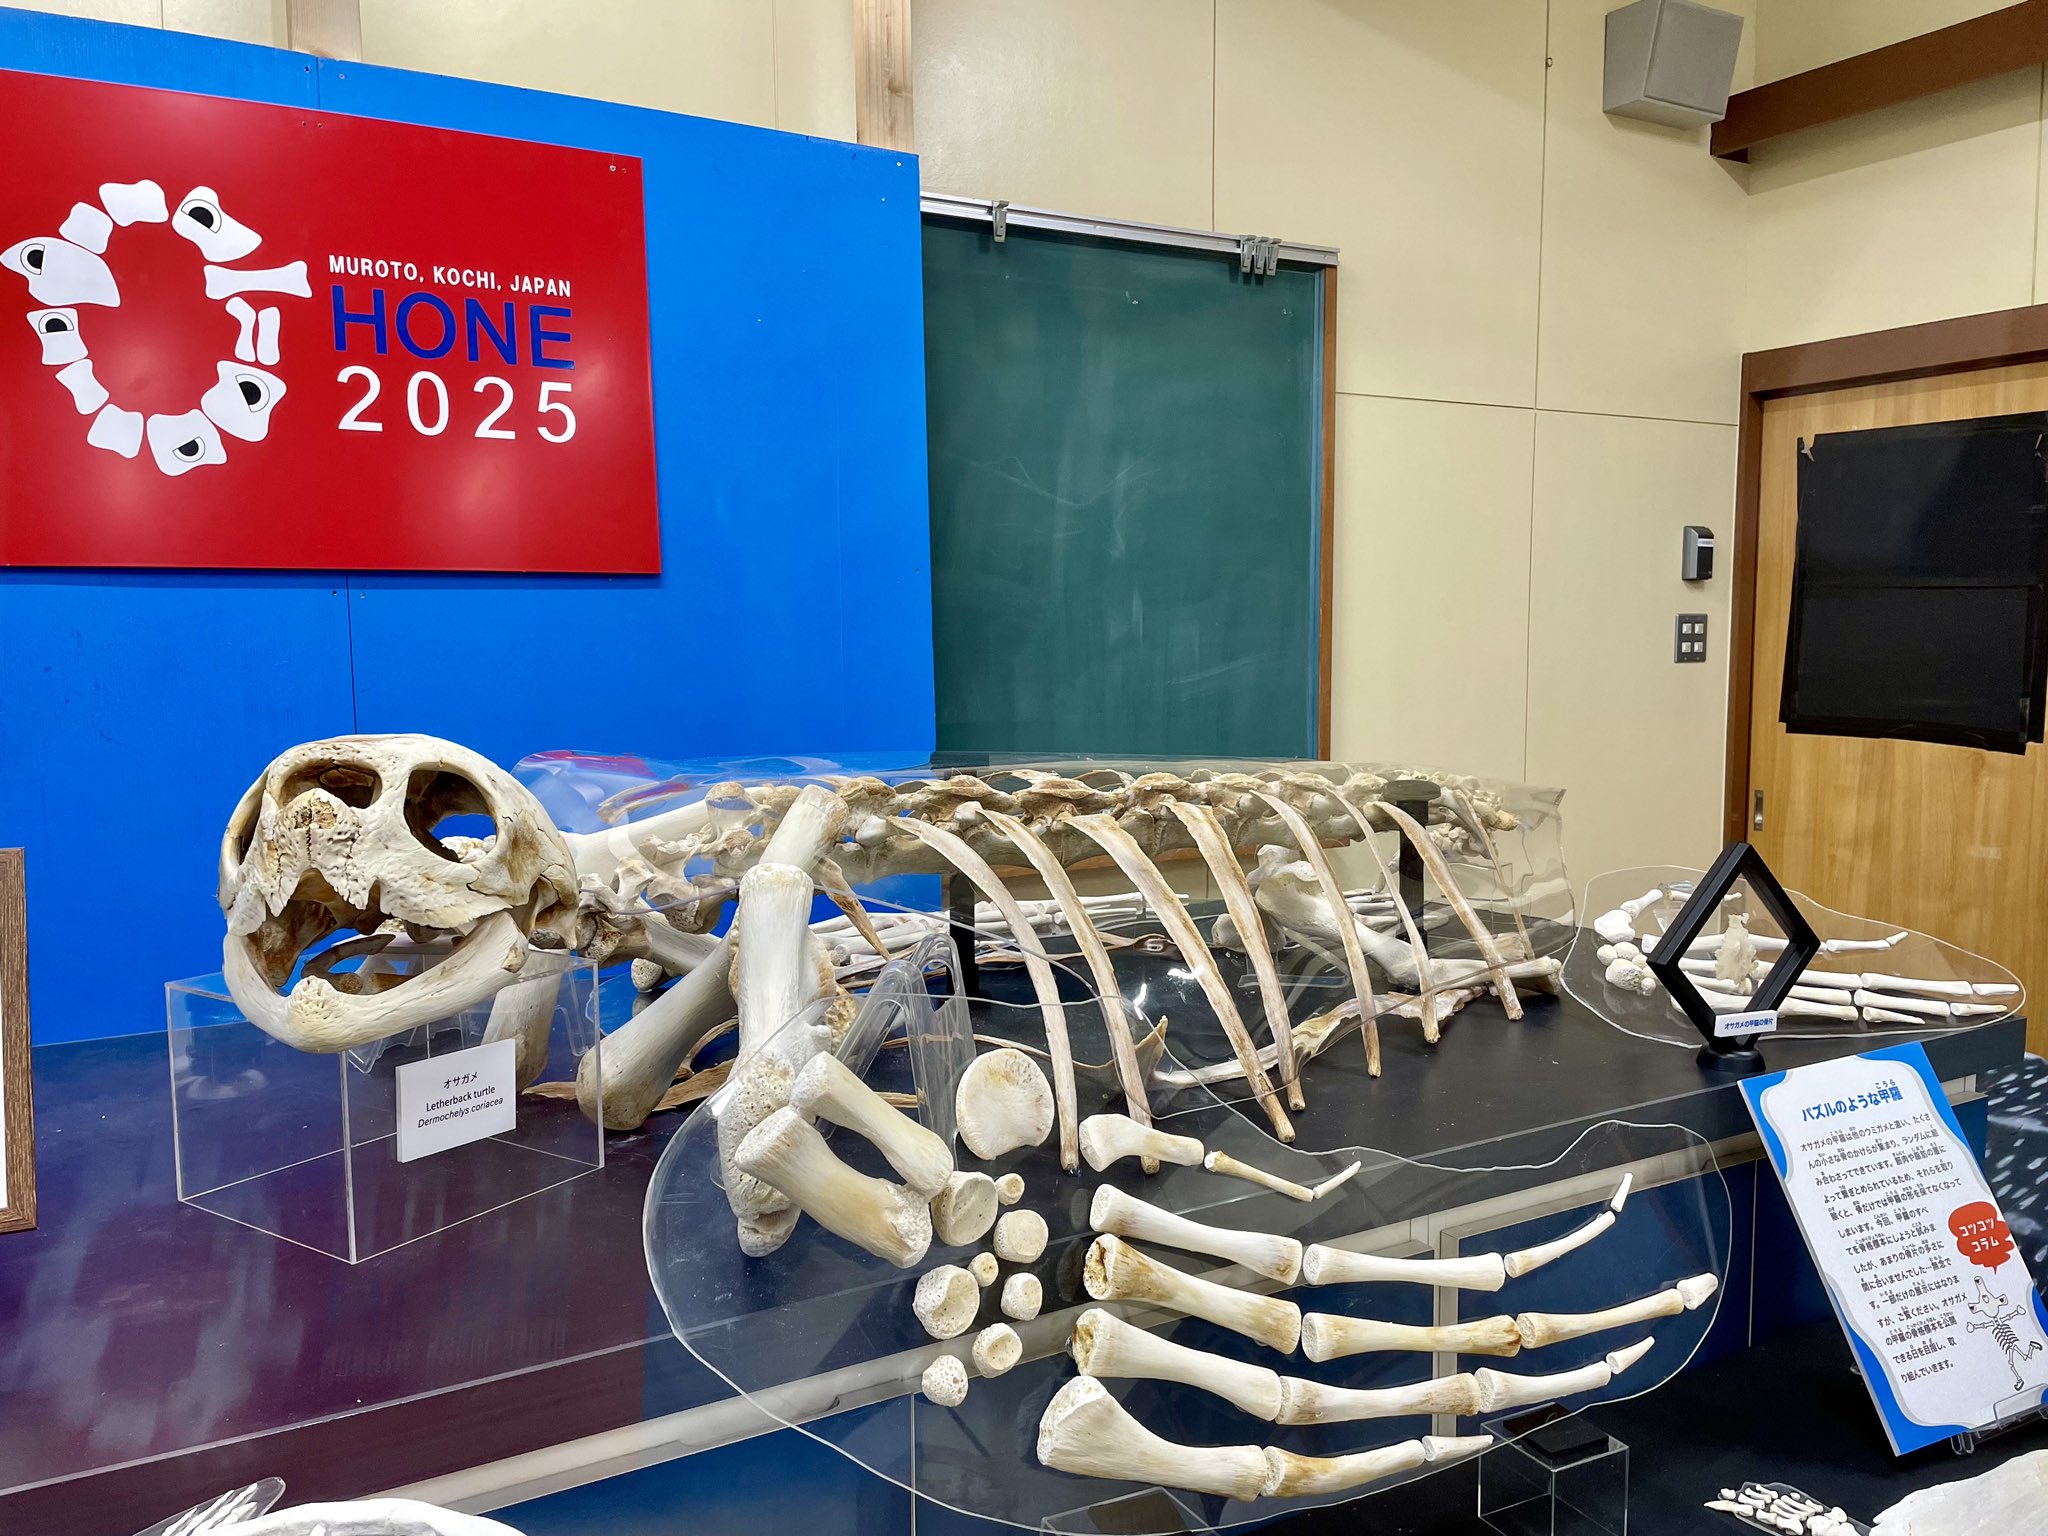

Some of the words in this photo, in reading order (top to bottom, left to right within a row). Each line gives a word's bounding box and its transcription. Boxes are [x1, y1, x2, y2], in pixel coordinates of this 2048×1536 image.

[329, 254, 424, 283] MUROTO,
[433, 265, 501, 291] KOCHI,
[510, 274, 571, 297] JAPAN
[331, 284, 575, 370] HONE
[337, 365, 577, 443] 2025
[443, 1072, 478, 1089] オサガメ
[418, 1106, 470, 1128] Dermochelys
[471, 1098, 504, 1112] coriacea
[426, 1092, 472, 1112] Letherback
[474, 1086, 496, 1098] turtle
[1802, 1085, 1903, 1122] パズルのような甲羅
[1959, 1218, 1994, 1237] コツコツ
[1971, 1236, 1999, 1253] コラム
